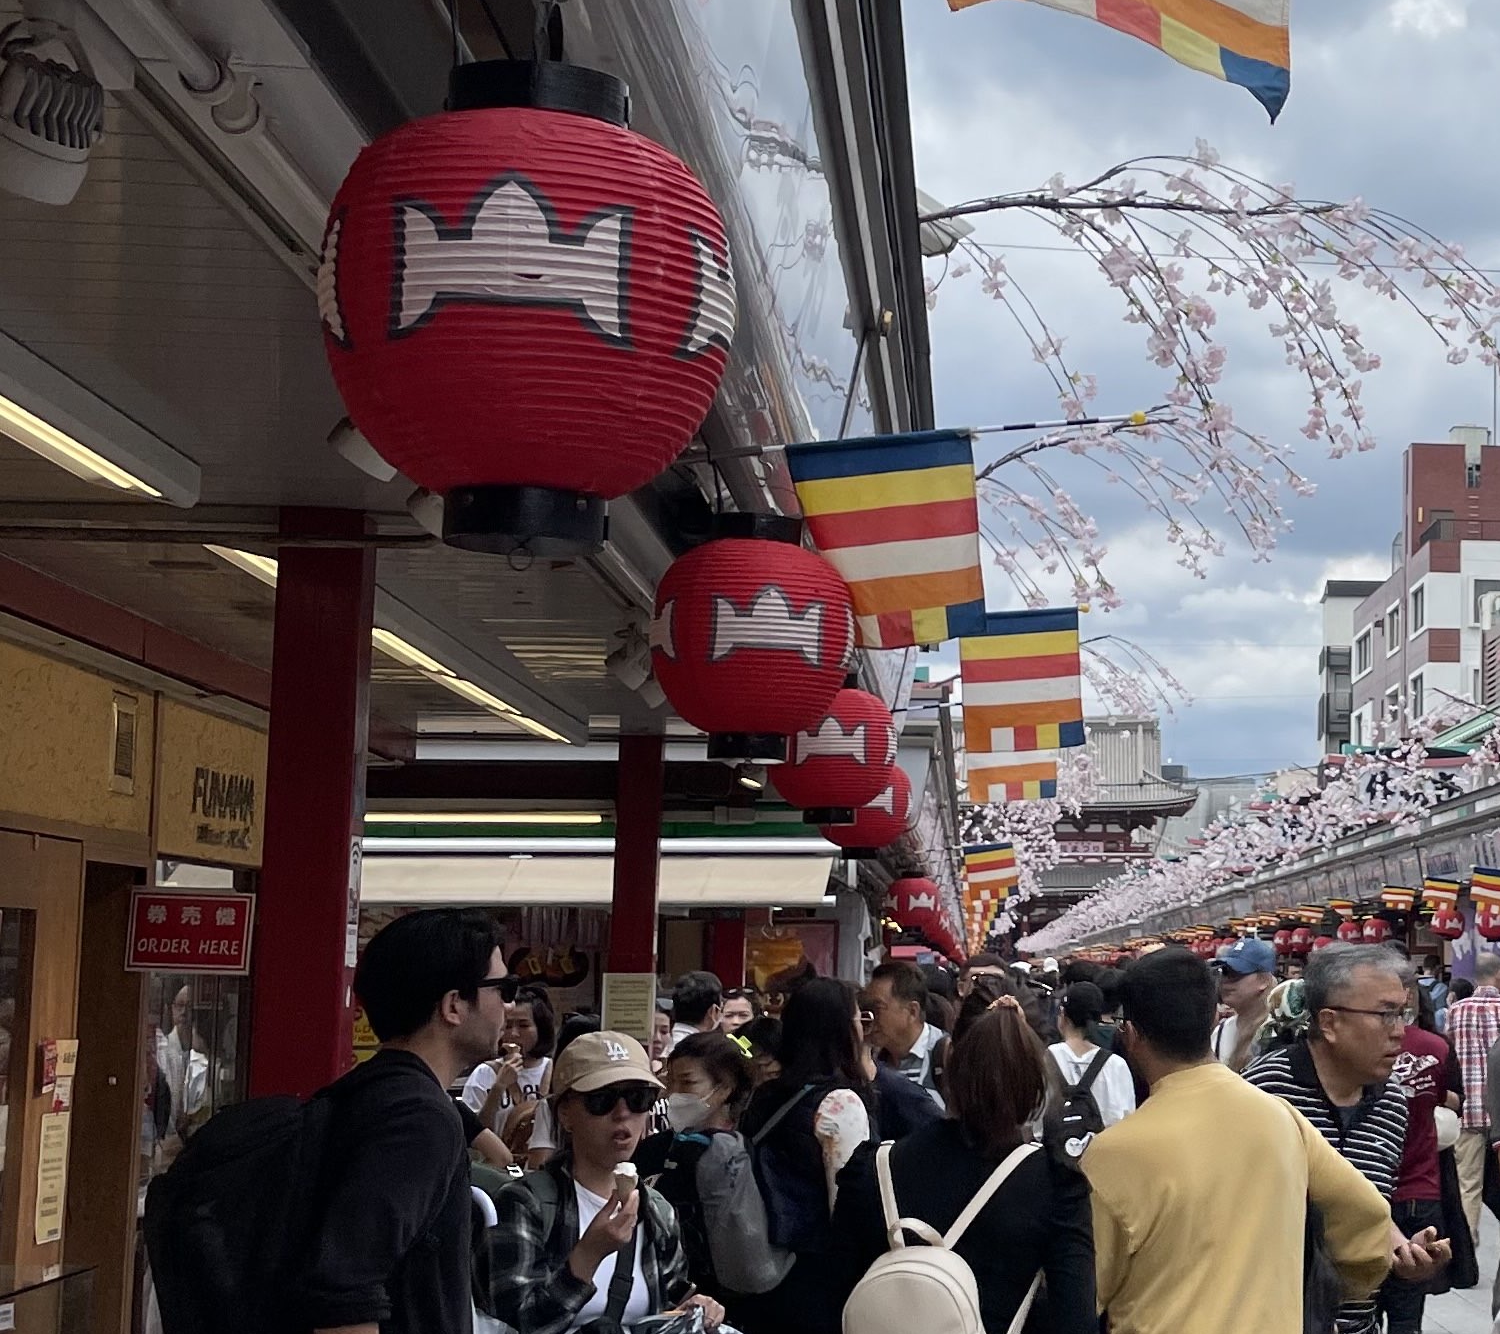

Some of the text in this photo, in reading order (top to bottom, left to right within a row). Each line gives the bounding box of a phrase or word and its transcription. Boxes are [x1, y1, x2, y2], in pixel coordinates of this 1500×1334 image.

[147, 905, 236, 926] 券売機
[137, 937, 240, 956] ORDER HERE
[602, 1039, 630, 1061] LA
